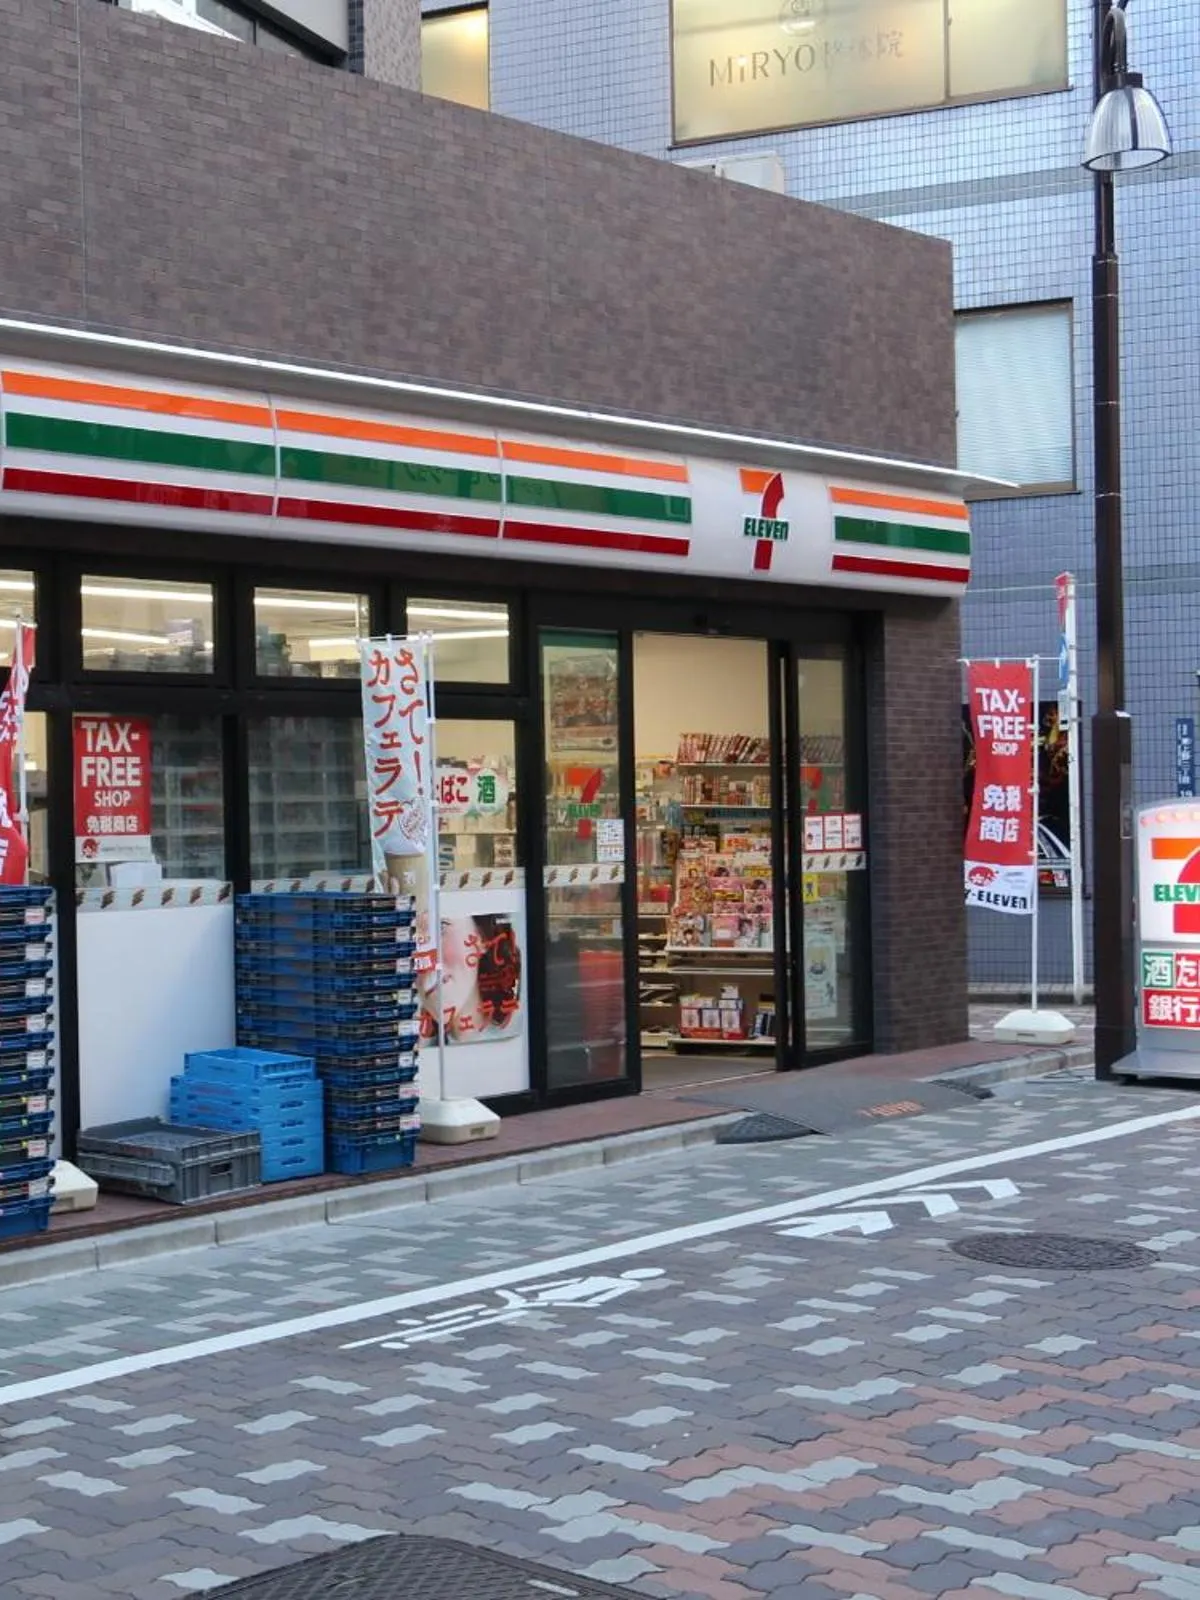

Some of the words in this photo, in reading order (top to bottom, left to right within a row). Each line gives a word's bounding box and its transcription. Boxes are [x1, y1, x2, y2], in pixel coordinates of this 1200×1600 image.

[976, 688, 1025, 712] TAX-
[81, 721, 141, 753] TAX-
[977, 715, 1026, 740] FREE
[367, 648, 404, 838] カフェラテ
[991, 742, 1019, 756] SHOP
[81, 756, 142, 788] FREE
[94, 790, 132, 808] SHOP
[436, 775, 470, 804] ばこ
[477, 775, 496, 804] 酒
[982, 785, 1022, 812] 免税
[86, 814, 138, 834] 免税商店
[980, 816, 1020, 843] 商店
[1145, 955, 1172, 987] 酒
[1176, 956, 1200, 988] た
